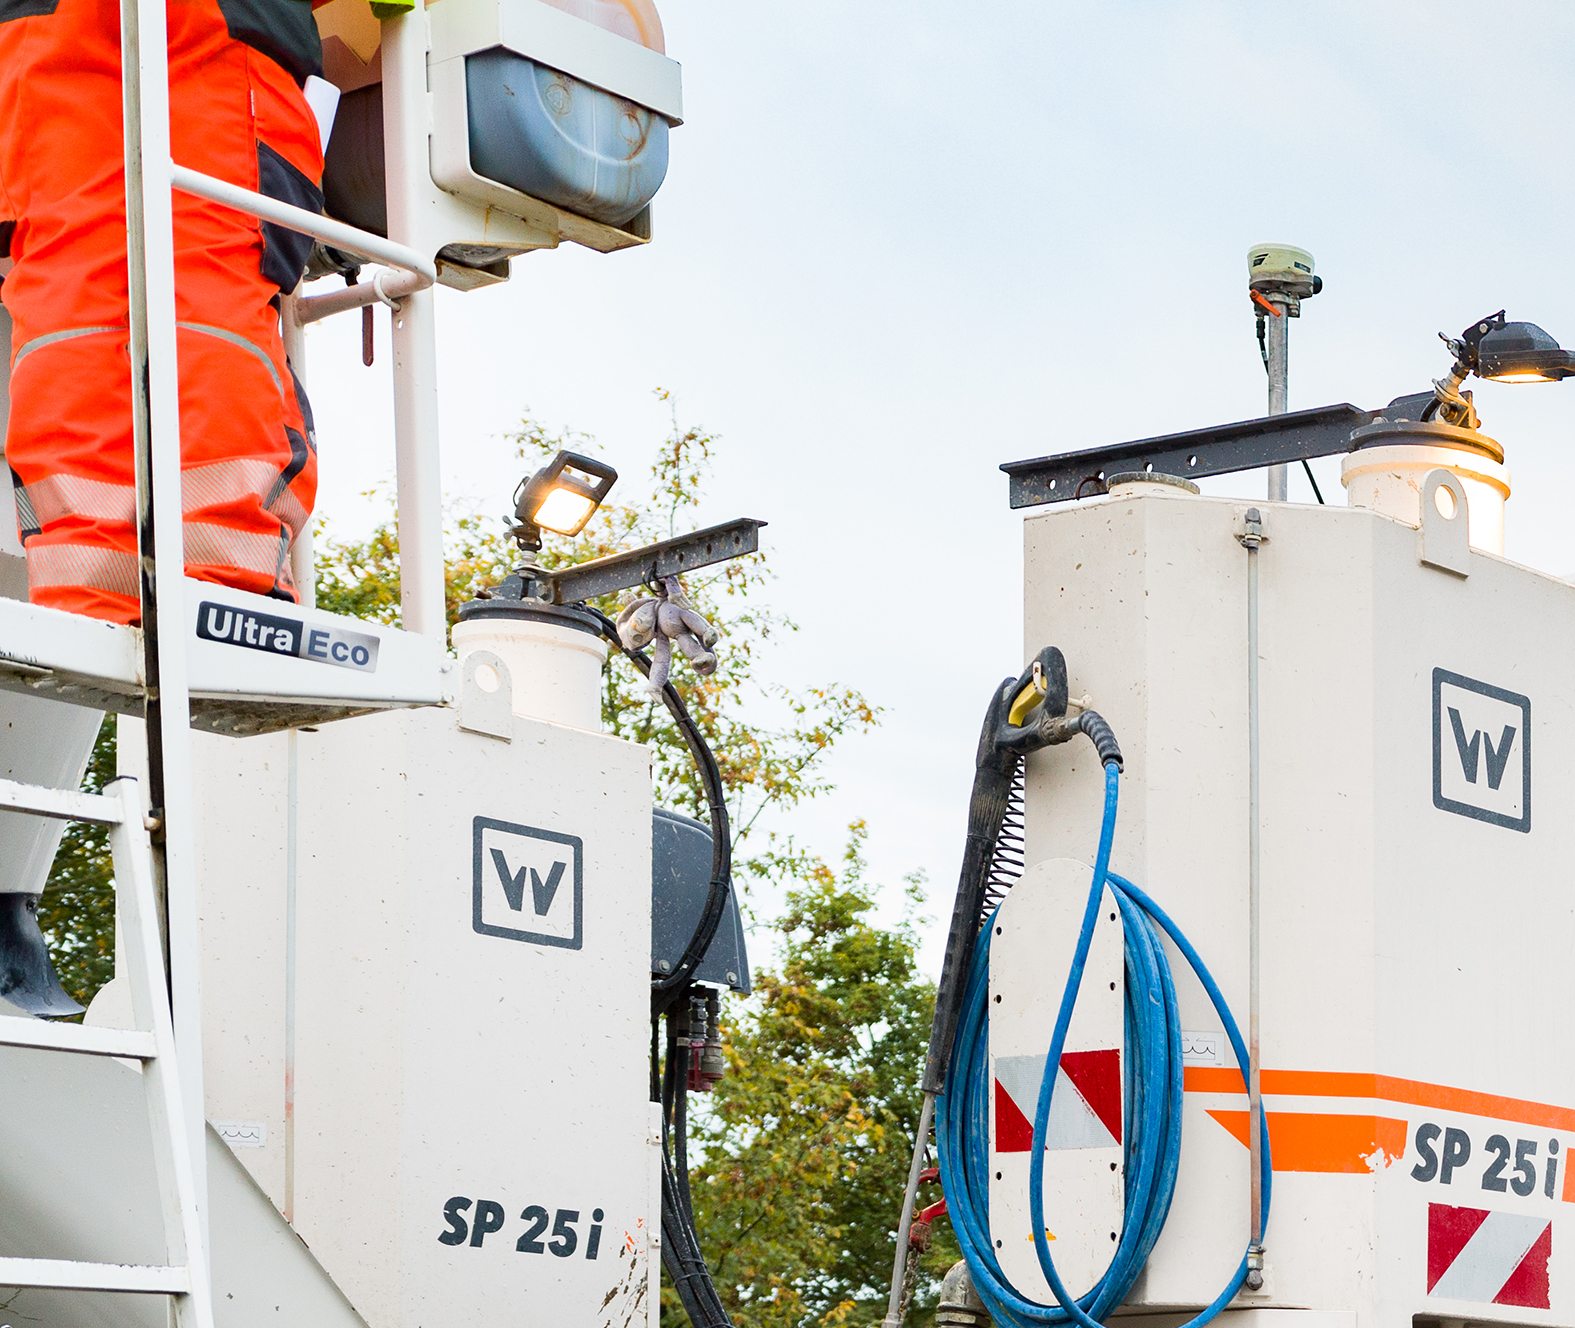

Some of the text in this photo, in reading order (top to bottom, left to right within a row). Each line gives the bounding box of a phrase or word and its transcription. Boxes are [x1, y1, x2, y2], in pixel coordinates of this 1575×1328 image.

[206, 607, 370, 666] Ultra Eco
[1410, 1122, 1472, 1185] SP
[437, 1196, 505, 1248] SP
